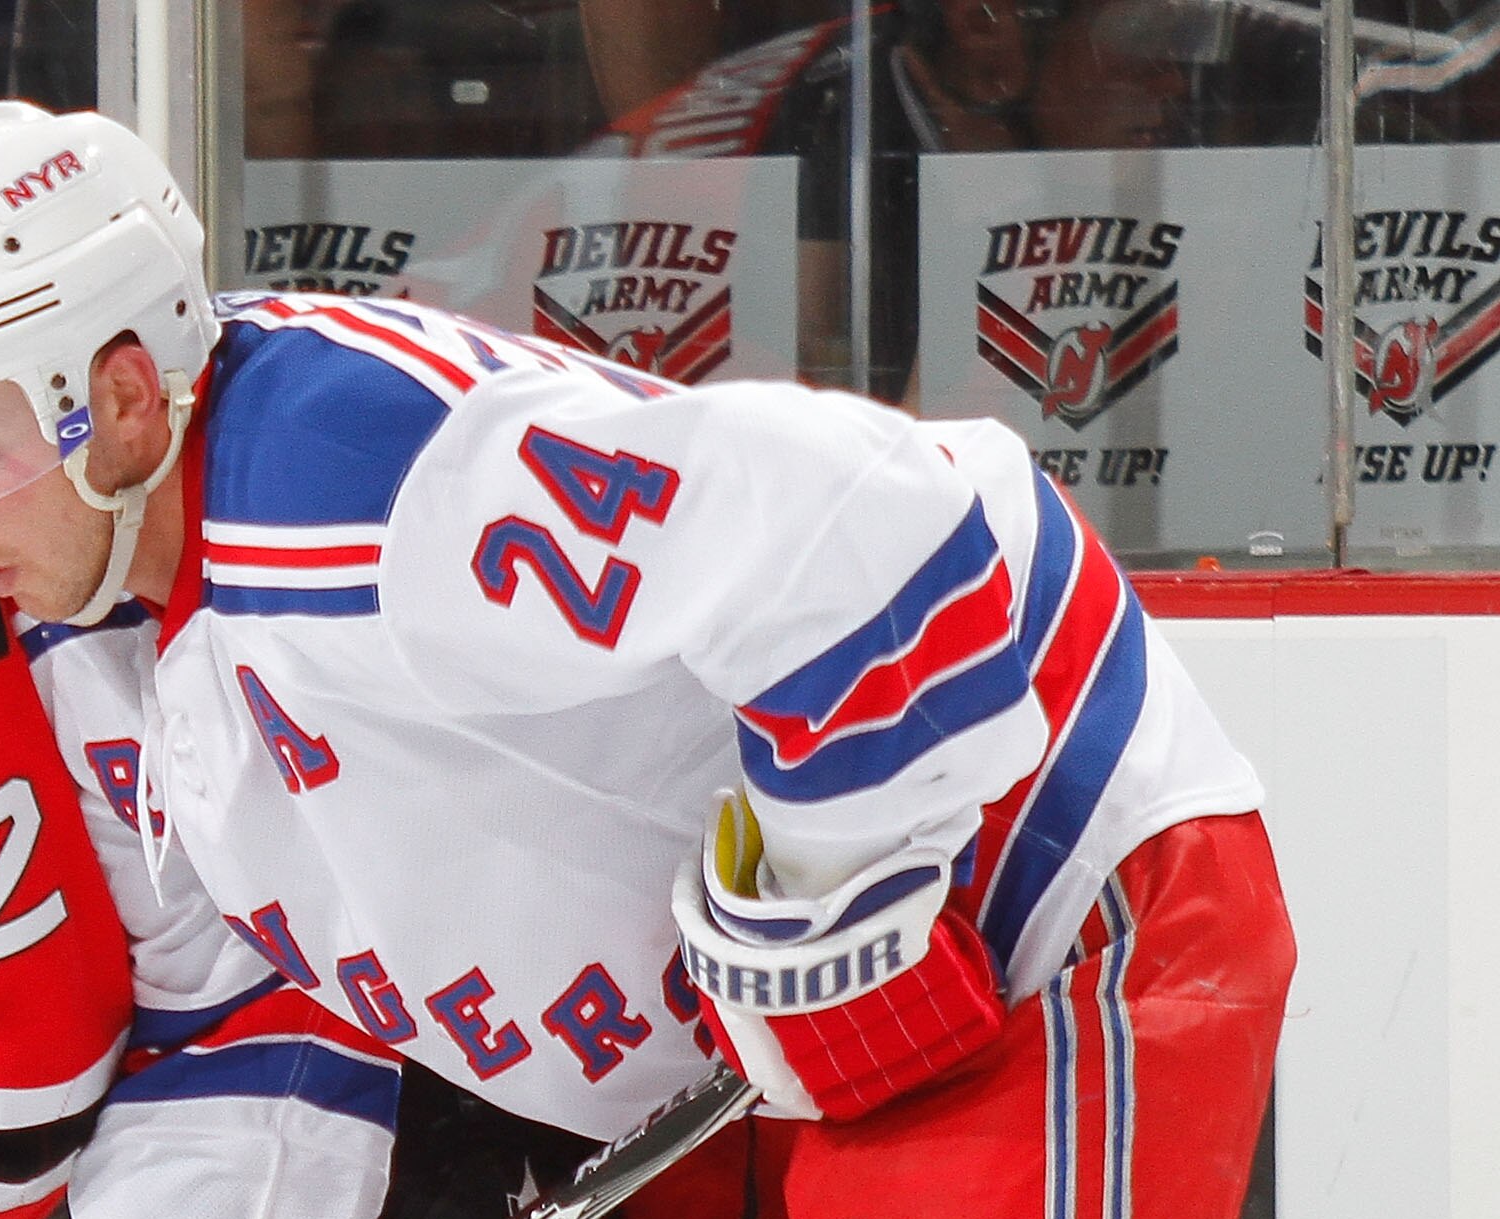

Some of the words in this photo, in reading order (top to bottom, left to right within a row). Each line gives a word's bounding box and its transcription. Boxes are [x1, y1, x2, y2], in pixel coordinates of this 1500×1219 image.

[0, 149, 85, 209] NYR
[538, 221, 737, 279] DEVILS
[982, 216, 1186, 275] DEVILS
[1311, 210, 1500, 268] EVILS
[580, 274, 702, 317] ARMY
[1027, 272, 1148, 314] ARMY
[1353, 264, 1477, 307] ARMY
[1035, 448, 1088, 485] SE
[1096, 448, 1169, 486] UP!
[1423, 444, 1496, 483] UP!
[470, 423, 681, 652] 24
[235, 663, 340, 795] A
[677, 926, 902, 1006] RRIOR
